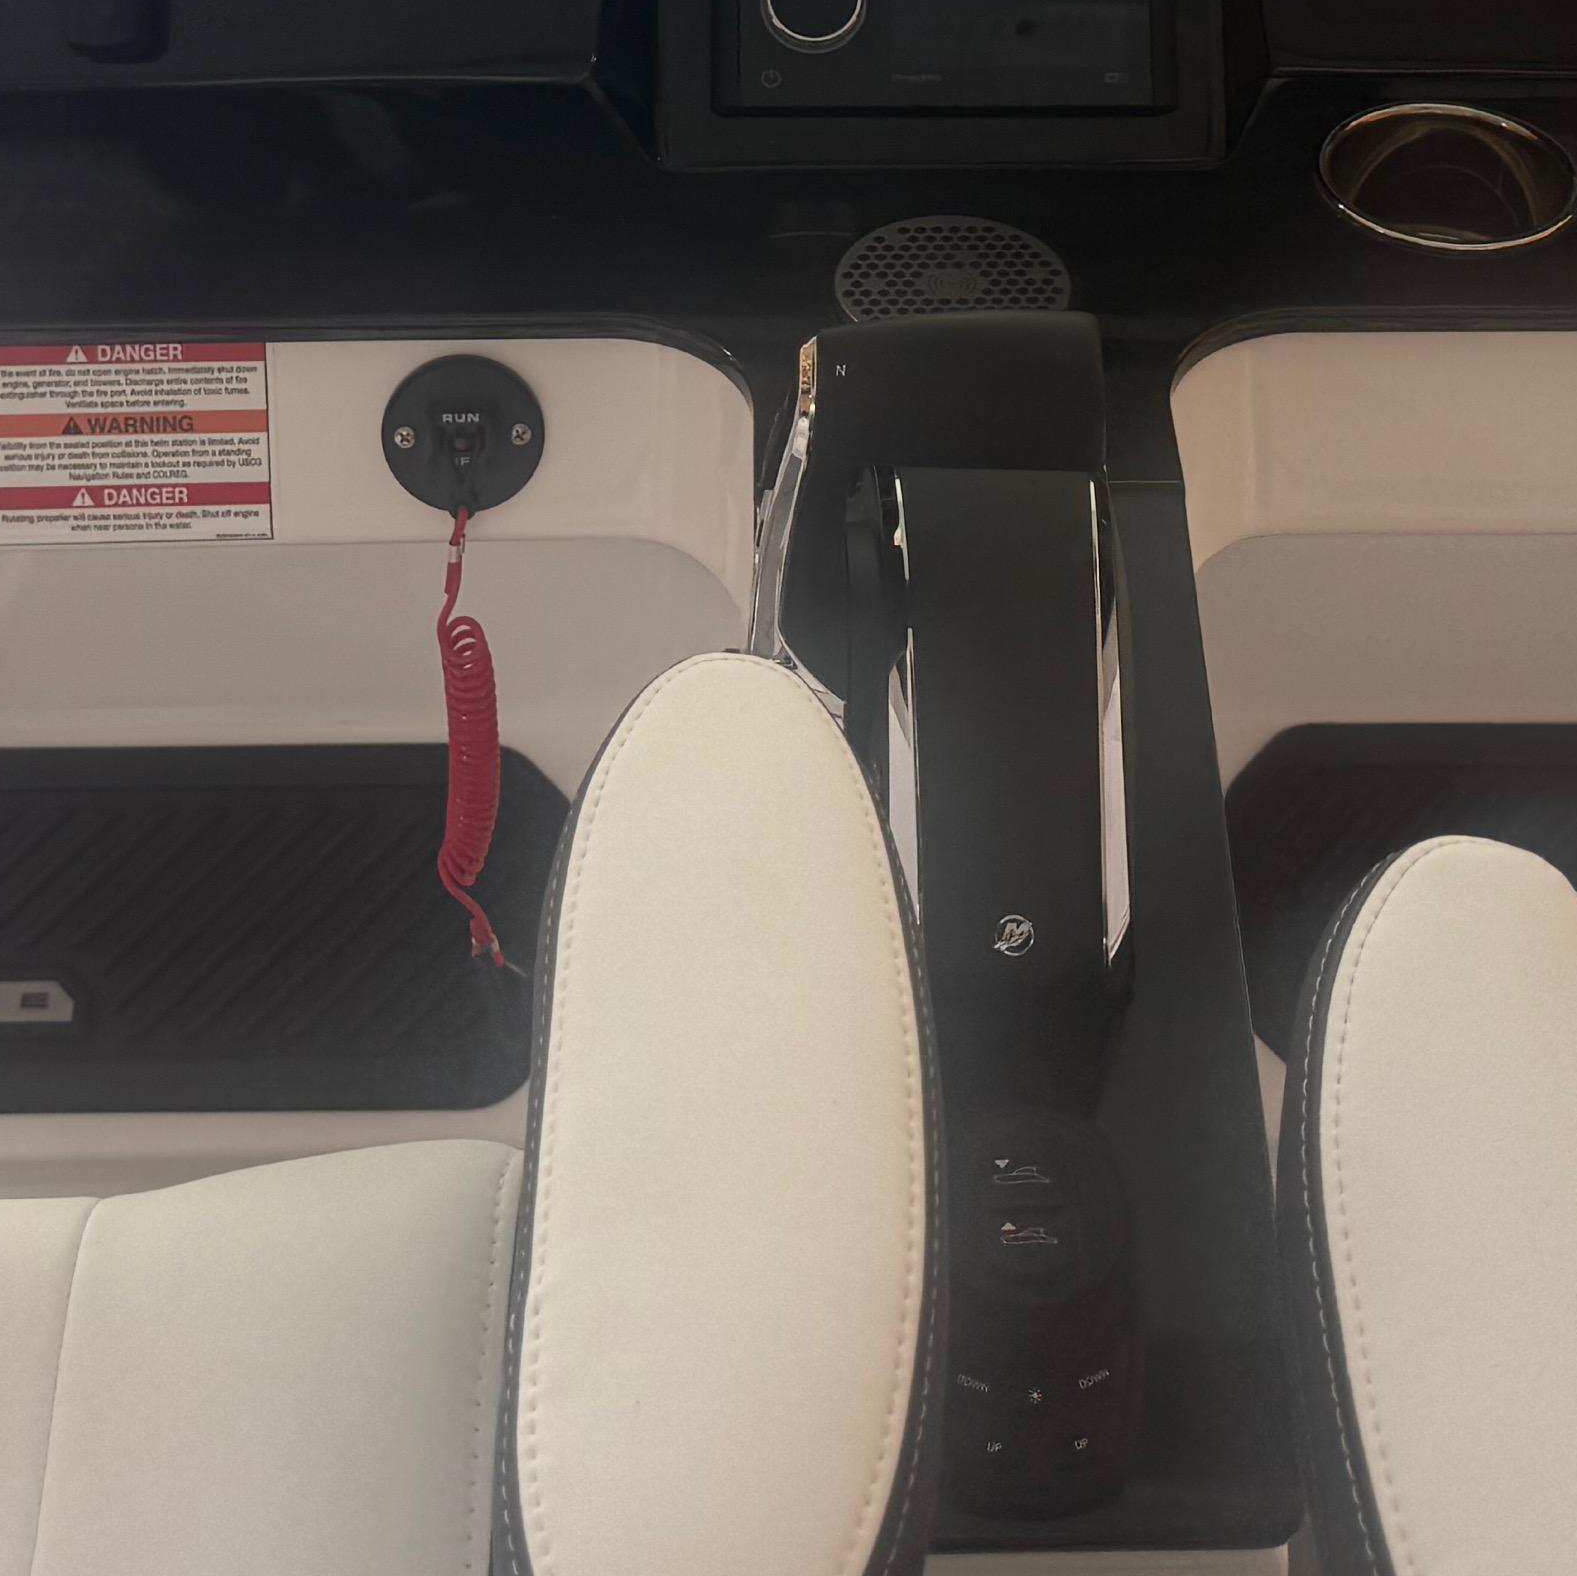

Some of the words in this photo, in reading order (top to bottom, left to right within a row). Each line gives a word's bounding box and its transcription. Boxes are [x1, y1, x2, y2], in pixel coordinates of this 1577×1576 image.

[97, 344, 183, 362] DANGER
[836, 364, 846, 377] N
[88, 415, 194, 434] WARNING
[442, 413, 480, 423] RUN
[103, 488, 188, 505] DANGER
[1078, 1369, 1110, 1389] DOWN
[986, 1441, 1002, 1452] UP
[1074, 1438, 1088, 1450] UP
